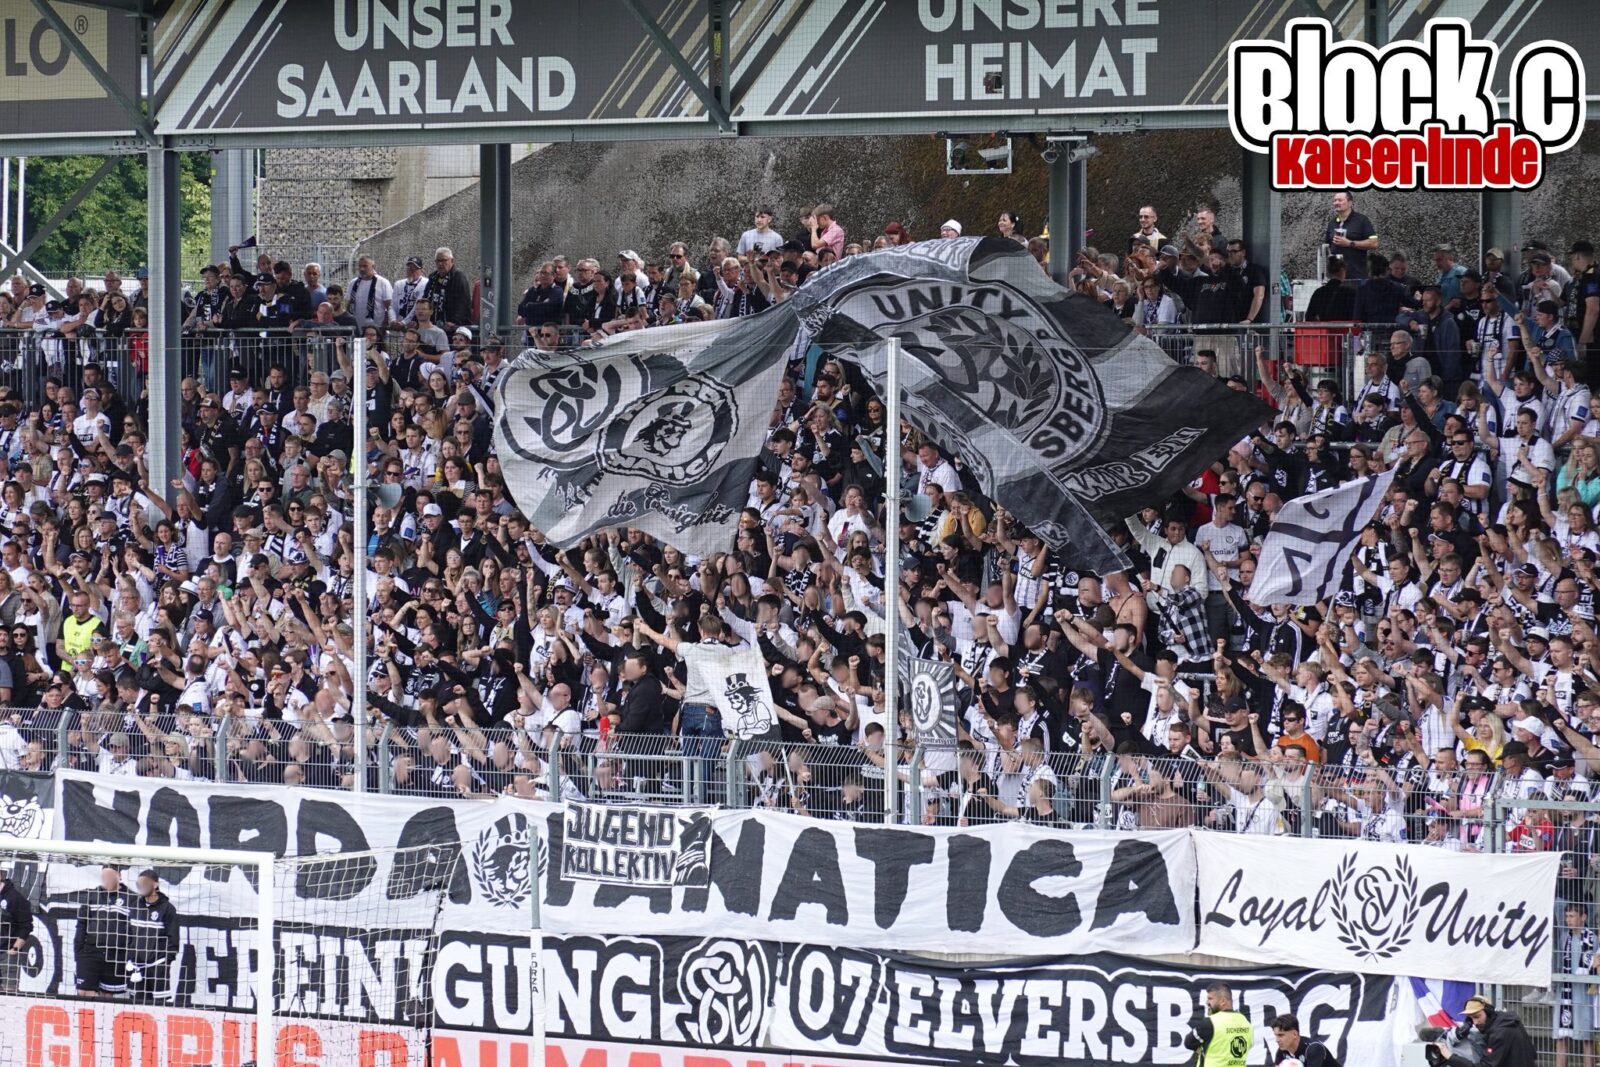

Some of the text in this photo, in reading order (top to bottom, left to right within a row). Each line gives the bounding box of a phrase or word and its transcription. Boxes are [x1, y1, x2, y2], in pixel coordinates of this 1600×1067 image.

[333, 0, 515, 51] UNSER
[917, 0, 1160, 33] UNSERE
[276, 55, 577, 119] SAARLAND
[924, 36, 1159, 101] HEIMAT
[869, 285, 1032, 322] UNITY
[567, 803, 676, 848] JUGEND
[563, 843, 679, 882] KOLLEKTIV
[1204, 868, 1550, 969] Loyal Unity
[892, 970, 1352, 1065] ELVERSBRG
